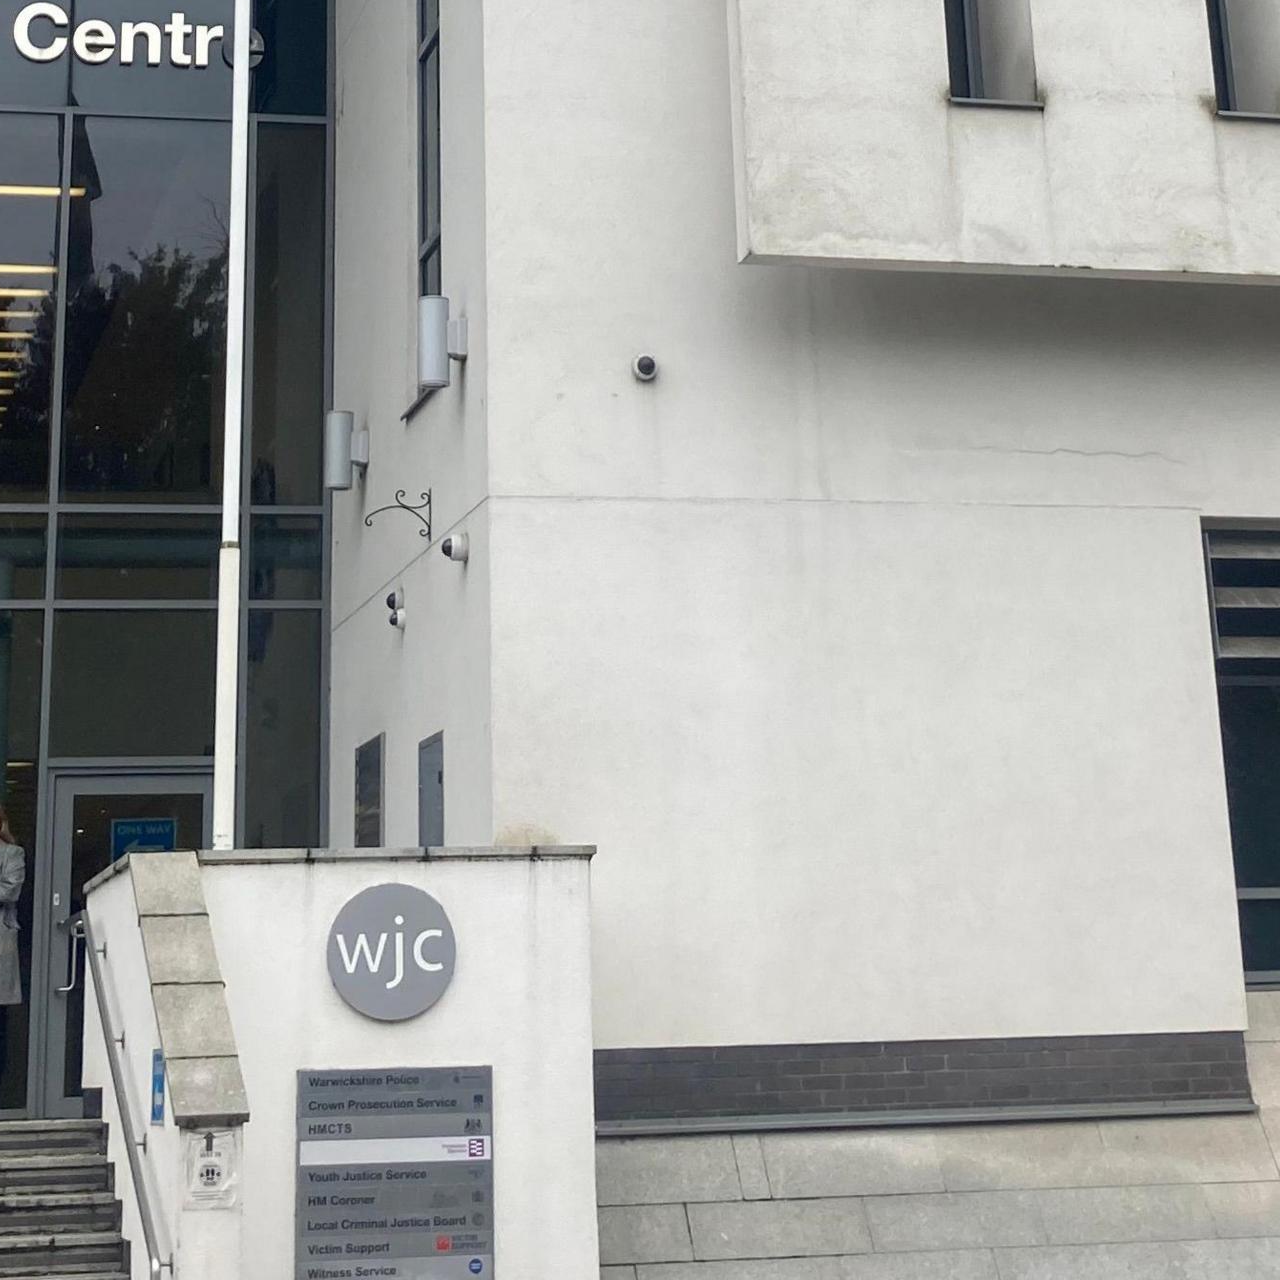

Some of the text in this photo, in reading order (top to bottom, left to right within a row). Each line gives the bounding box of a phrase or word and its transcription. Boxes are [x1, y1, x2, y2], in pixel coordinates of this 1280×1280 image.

[145, 823, 171, 835] WAY
[336, 915, 443, 989] wjc
[308, 1074, 420, 1087] Warwickshire Police
[308, 1097, 457, 1111] Crown Prosecution Service
[308, 1123, 352, 1135] HMCTS
[308, 1169, 427, 1183] Youth Justice Service
[307, 1195, 376, 1207] HM Coroner
[307, 1216, 466, 1231] Local Criminal Justice Board
[307, 1243, 390, 1255] Victim Support
[307, 1266, 397, 1279] Witness Service
